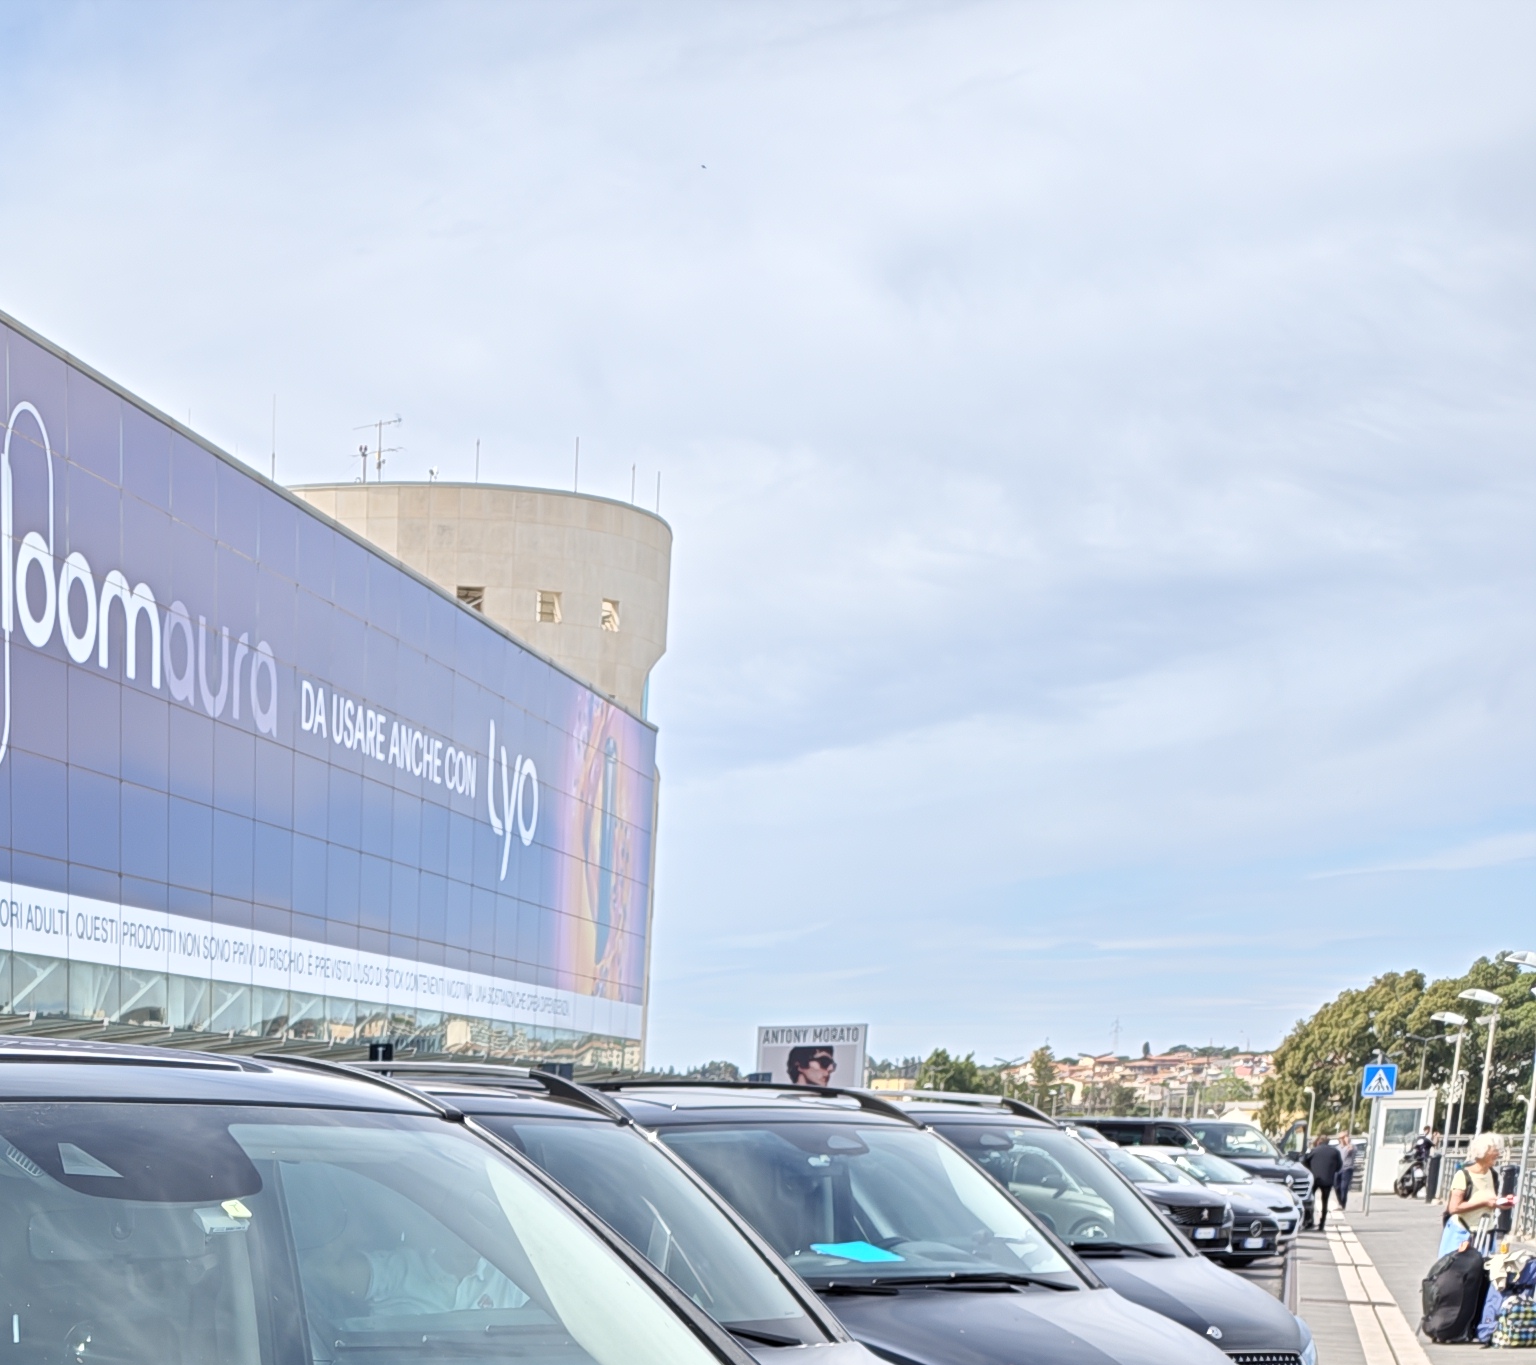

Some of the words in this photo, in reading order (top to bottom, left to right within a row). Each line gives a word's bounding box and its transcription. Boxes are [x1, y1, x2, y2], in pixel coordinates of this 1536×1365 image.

[301, 679, 327, 739] DA
[332, 693, 386, 762] USARE
[388, 721, 443, 785] ANCHE
[445, 746, 477, 799] CON
[25, 905, 72, 937] ADULTI.
[76, 912, 118, 945] QUESTI
[122, 921, 176, 954] PRODOTTI
[179, 931, 200, 958] NON
[203, 935, 231, 963] SONO
[762, 1029, 809, 1045] ANTONY
[812, 1027, 860, 1043] MORATO
